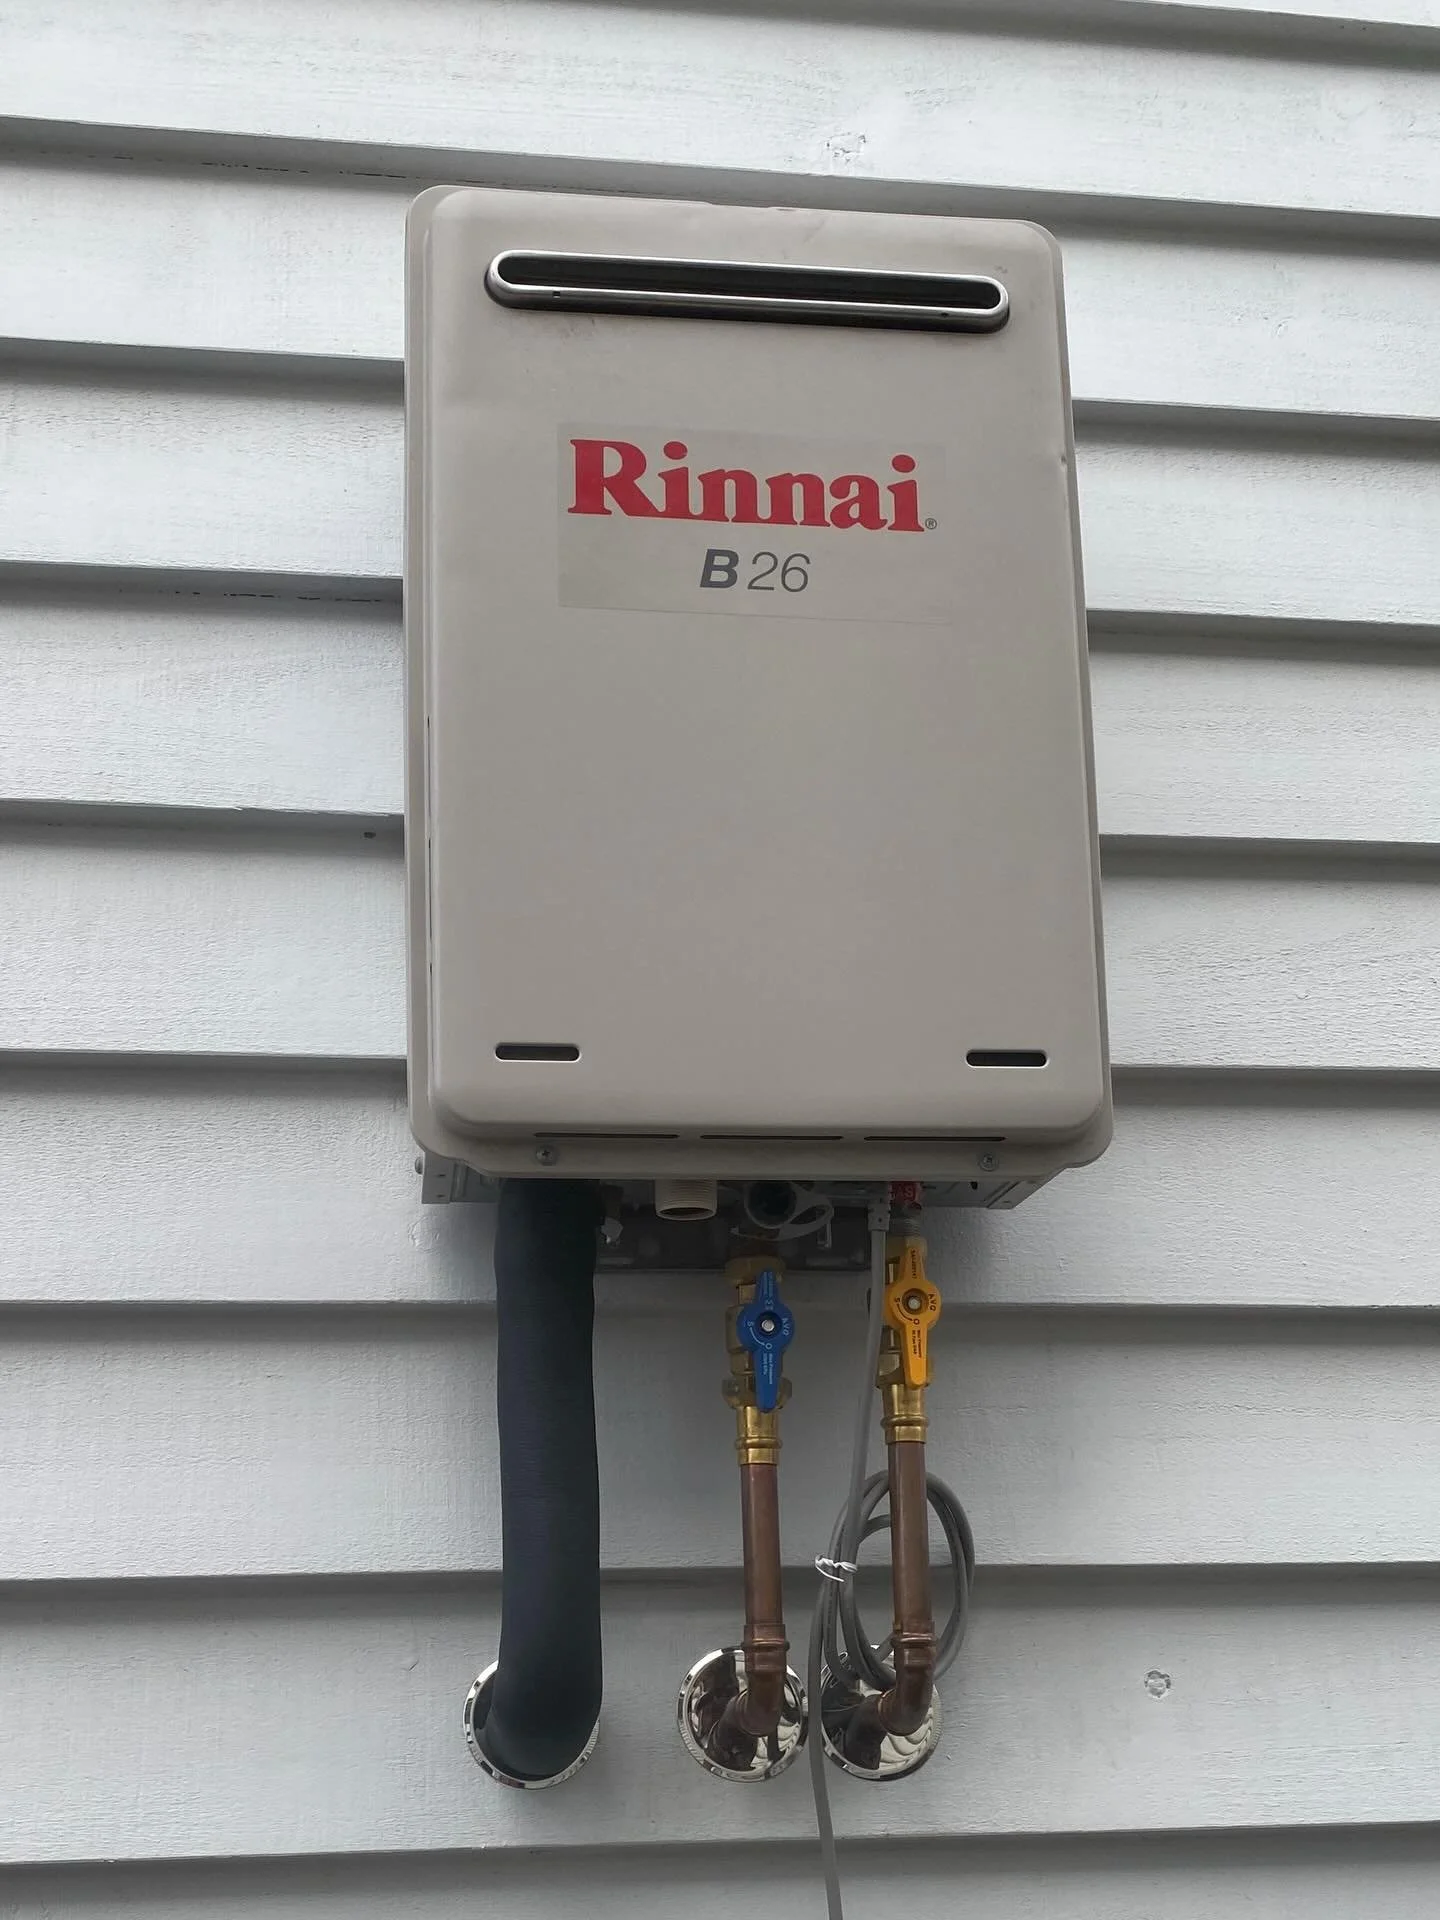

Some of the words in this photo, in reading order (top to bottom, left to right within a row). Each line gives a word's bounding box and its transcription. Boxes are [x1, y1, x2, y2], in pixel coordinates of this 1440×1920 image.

[568, 439, 924, 532] Rinnai
[699, 548, 740, 589] B
[747, 551, 812, 593] 26
